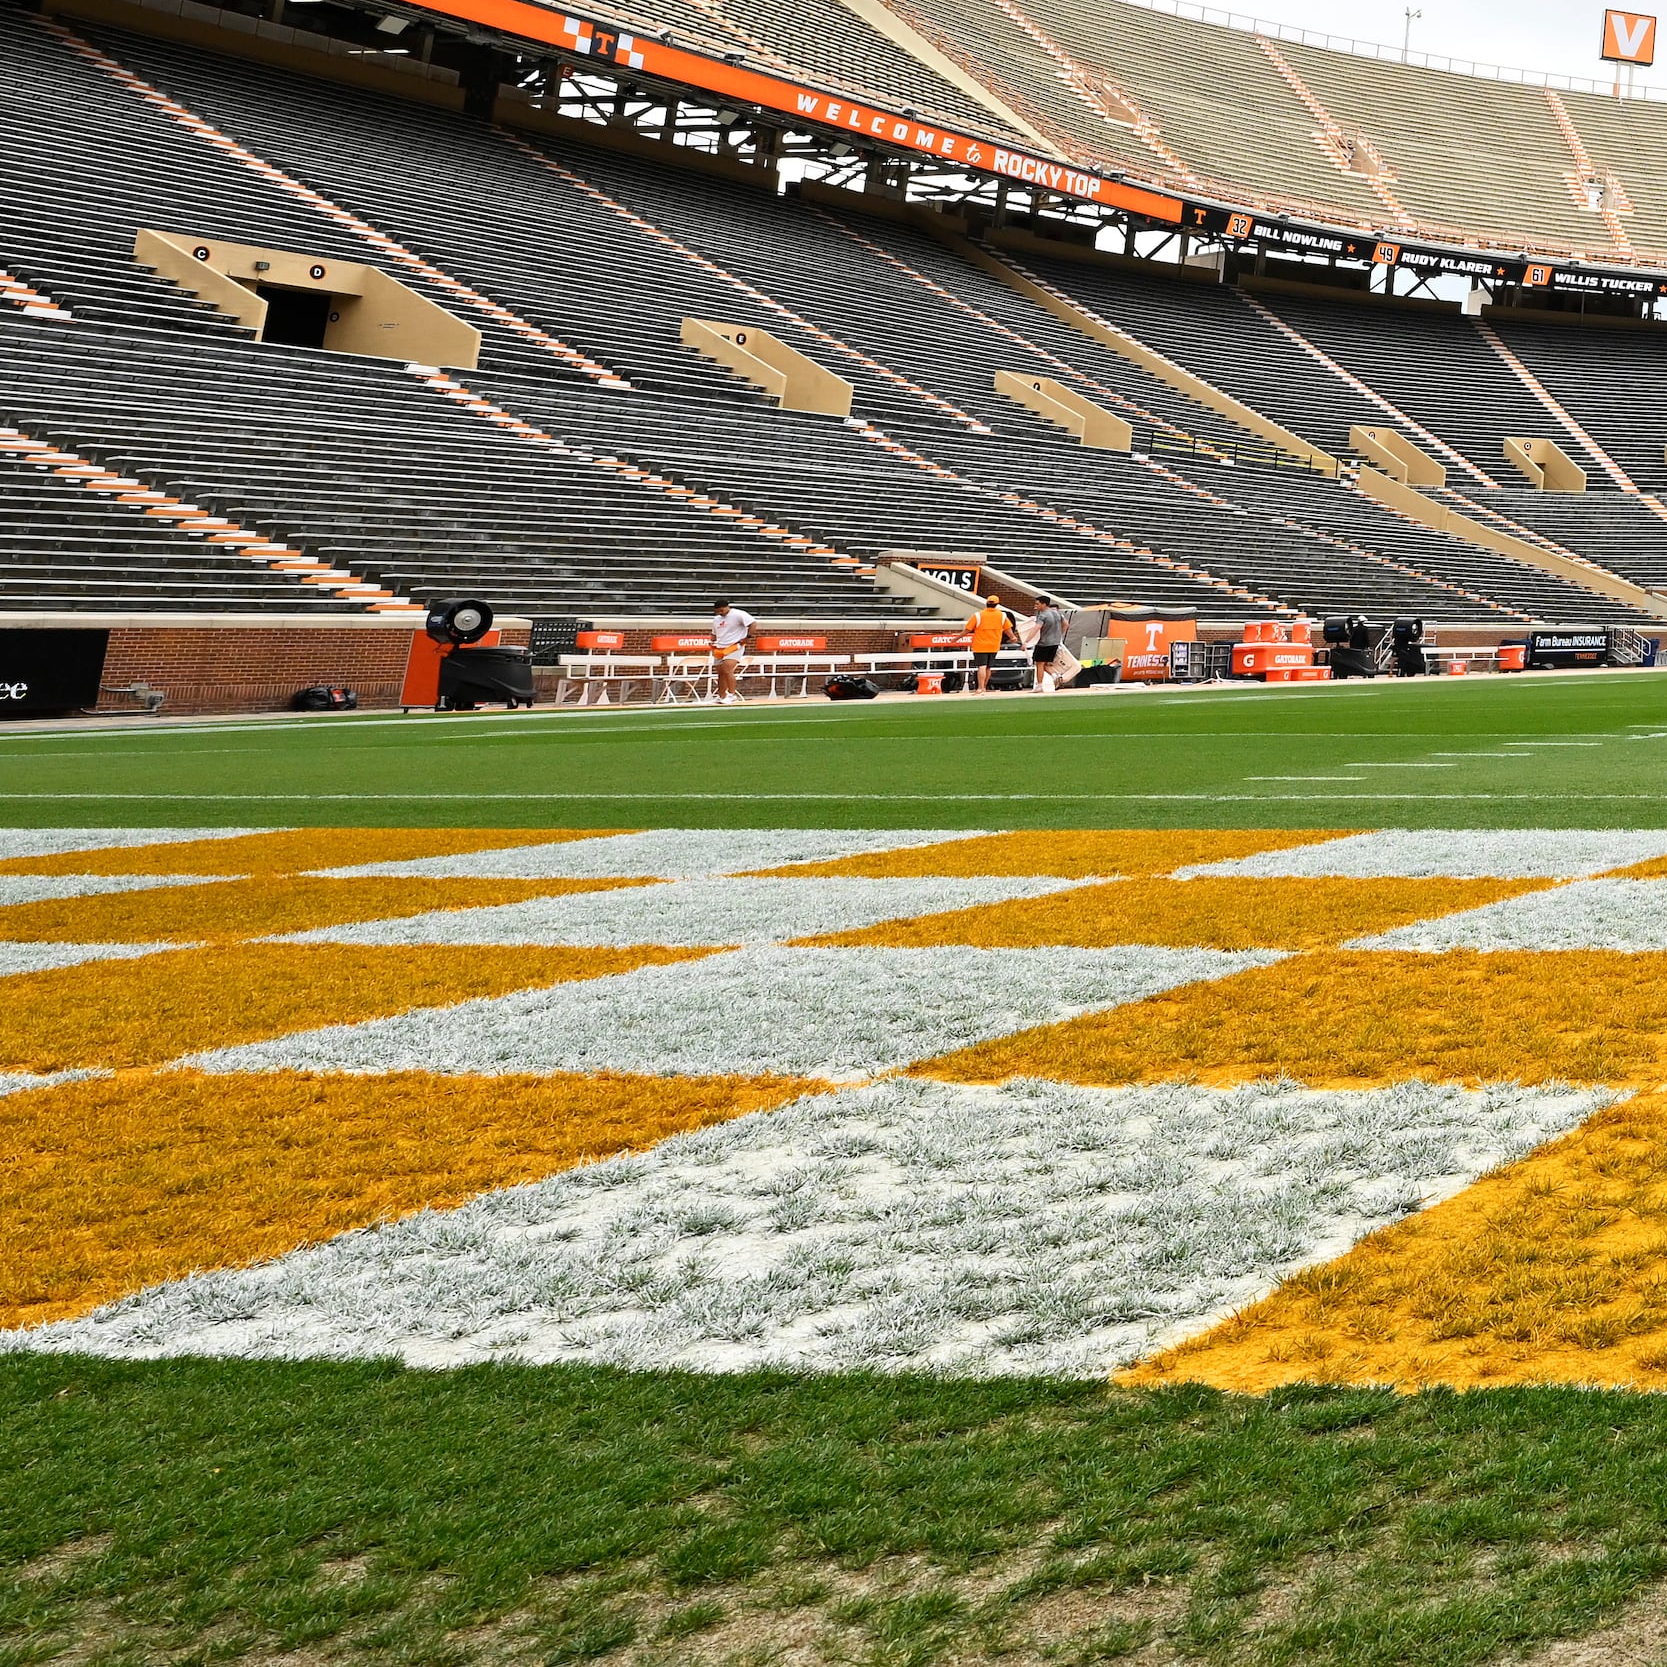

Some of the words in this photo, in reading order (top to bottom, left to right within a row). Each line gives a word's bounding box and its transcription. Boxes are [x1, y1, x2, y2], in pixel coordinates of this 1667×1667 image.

[595, 31, 615, 56] T
[797, 93, 955, 154] WELCOME
[965, 143, 982, 164] to
[993, 150, 1064, 188] ROCKY
[1064, 173, 1100, 199] TOP
[1194, 209, 1207, 225] T
[1232, 215, 1248, 234] 32
[1253, 224, 1281, 242] BILL
[1282, 231, 1343, 252] NOWLING
[1378, 246, 1395, 263] 49
[1401, 252, 1438, 267] RUDY
[1438, 258, 1493, 275] KLARER
[1532, 268, 1545, 283] 61
[1554, 272, 1598, 288] WILLIS
[1601, 278, 1654, 293] TUCKER
[779, 639, 814, 647] GATORADE
[1146, 623, 1163, 651] T
[1535, 636, 1551, 647] Farm
[1551, 636, 1571, 647] Bureau
[1572, 636, 1606, 647] INSURANCE
[1243, 654, 1254, 667] G
